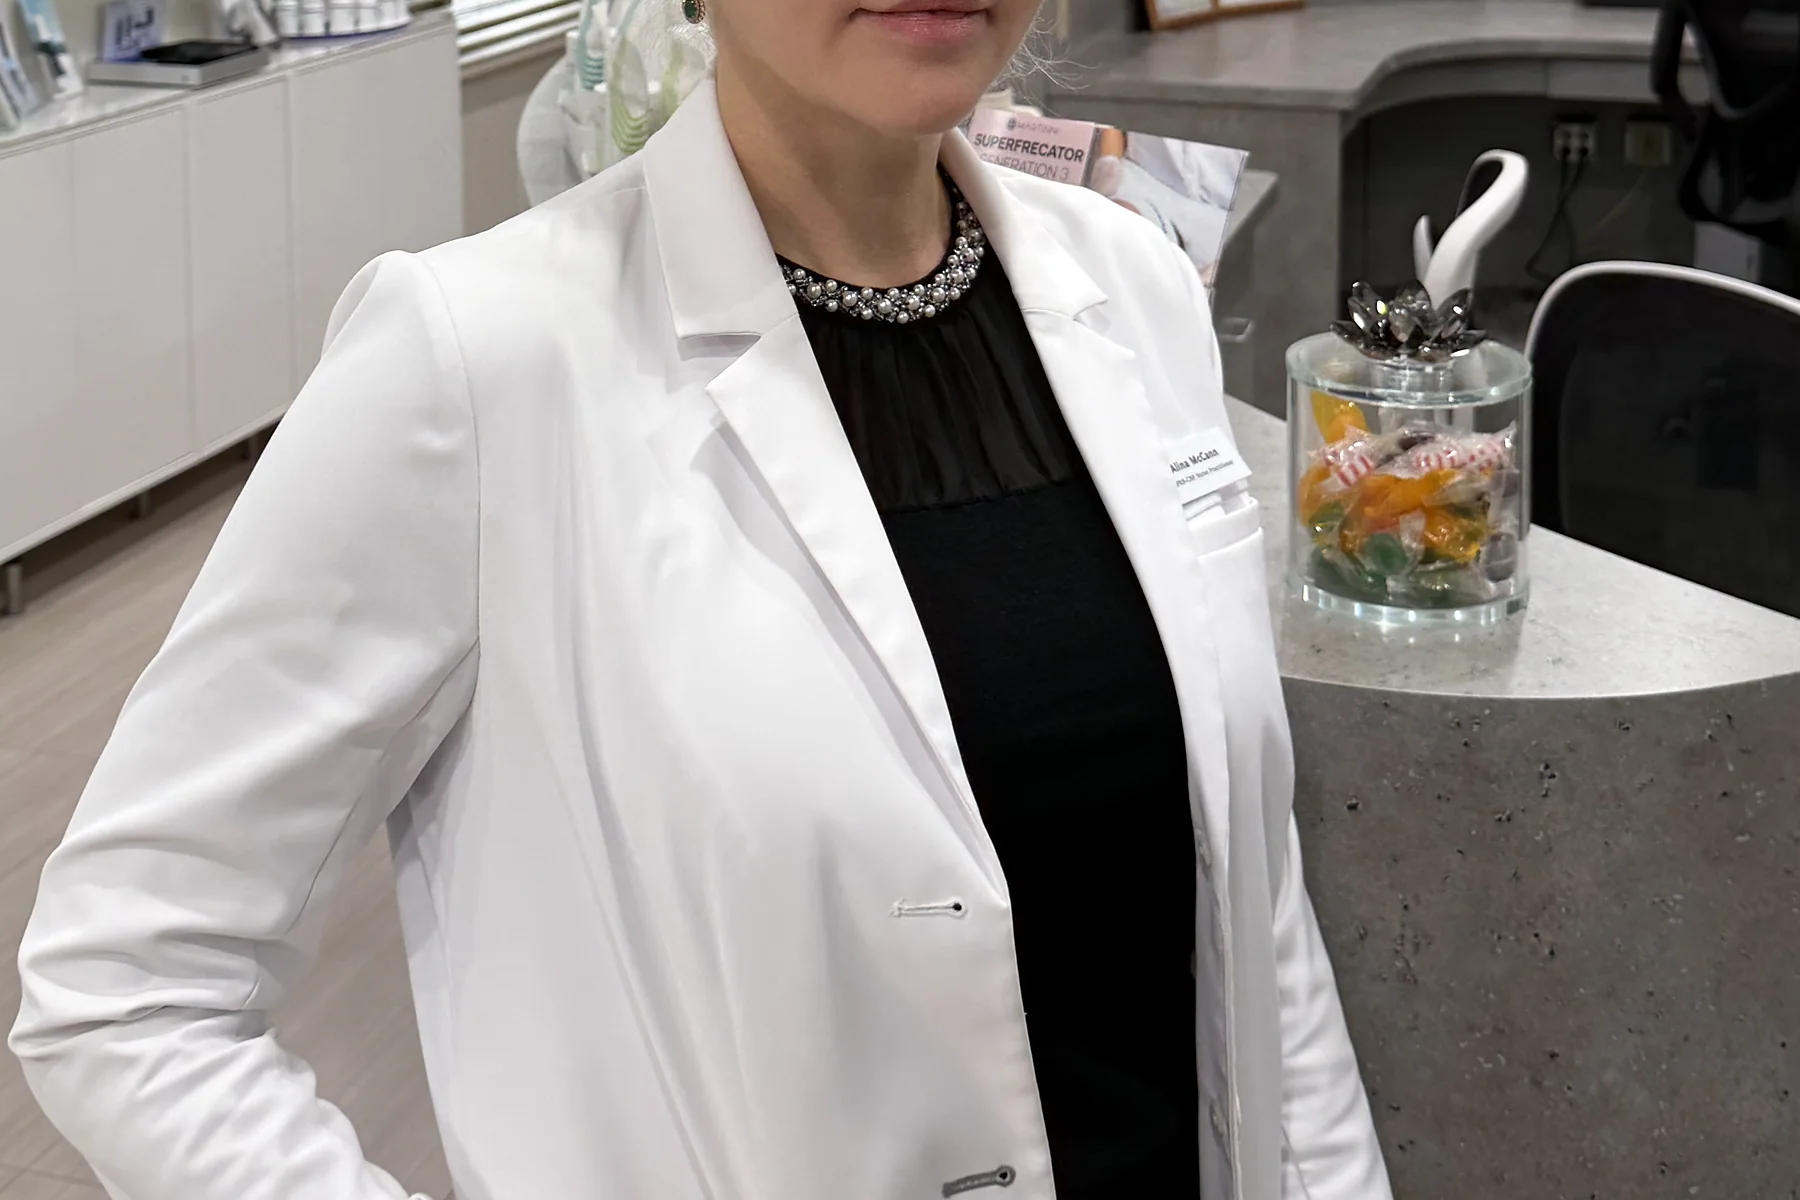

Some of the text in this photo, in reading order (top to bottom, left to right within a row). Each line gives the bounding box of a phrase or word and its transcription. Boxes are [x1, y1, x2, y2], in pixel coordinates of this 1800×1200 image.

[974, 133, 1084, 162] SUPERFRECATOR
[1060, 167, 1069, 180] 3
[1169, 449, 1219, 473] Alina McCann
